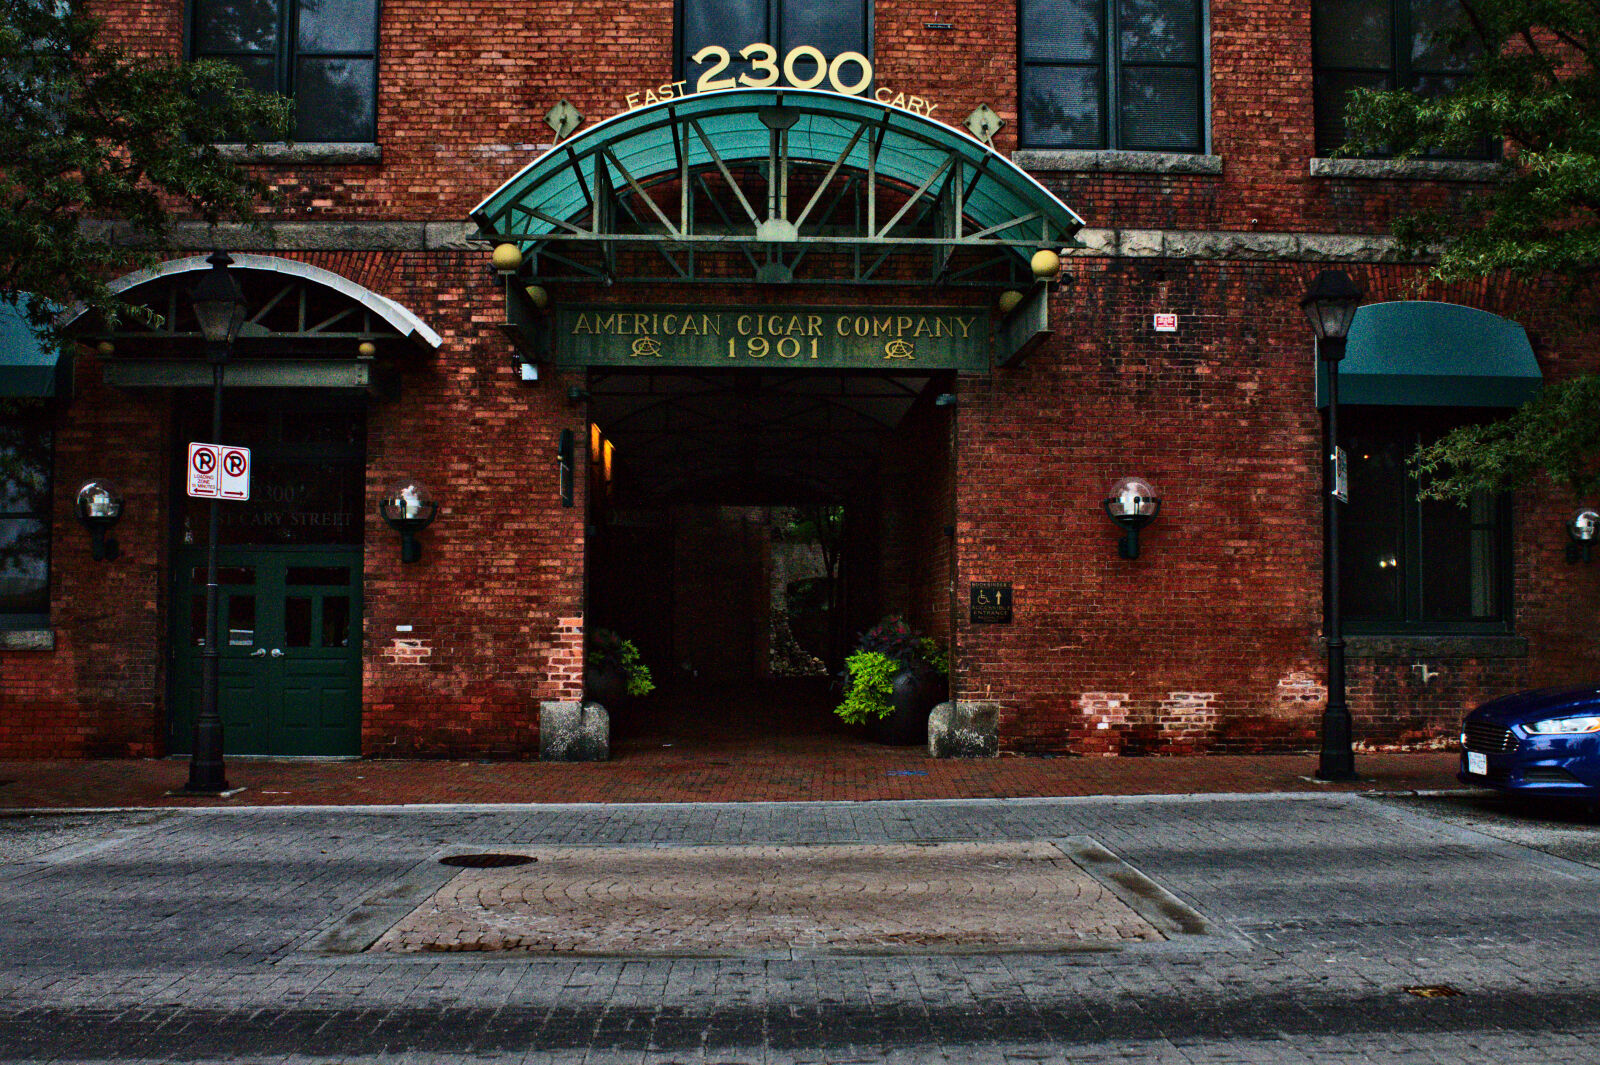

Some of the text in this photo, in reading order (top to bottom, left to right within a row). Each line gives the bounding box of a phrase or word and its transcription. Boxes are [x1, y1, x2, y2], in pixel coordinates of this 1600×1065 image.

[625, 42, 937, 119] EAST 2300 CARY
[571, 313, 976, 338] AMERICAN CIGAR COMPANY
[727, 336, 818, 359] 1901
[238, 511, 284, 526] CARY
[290, 511, 353, 526] STREET
